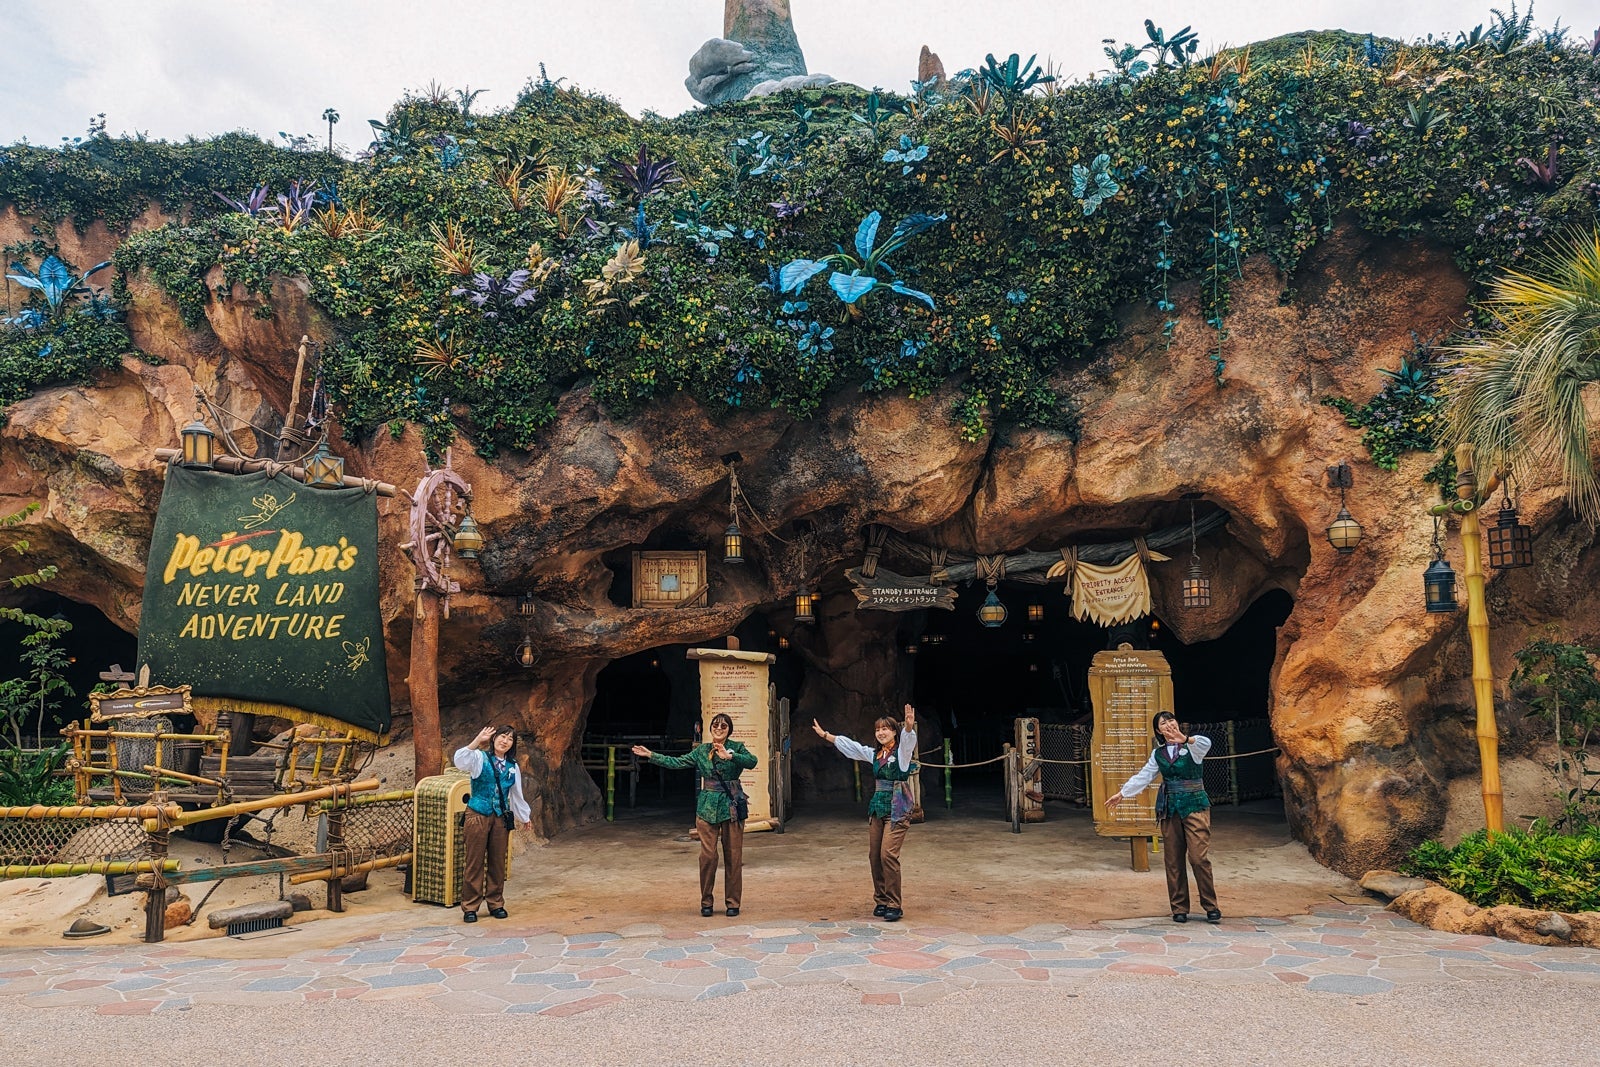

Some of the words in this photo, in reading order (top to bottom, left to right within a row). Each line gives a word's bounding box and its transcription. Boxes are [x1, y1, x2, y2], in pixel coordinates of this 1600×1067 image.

[265, 528, 358, 580] Pan's
[871, 587, 902, 596] STANDBY
[1081, 579, 1111, 590] PRIORITY
[1113, 575, 1136, 585] ACCESS
[1095, 585, 1126, 597] ENTRANCE
[176, 582, 260, 607] NEVER
[275, 582, 345, 607] LAND
[179, 613, 346, 640] ADVENTURE
